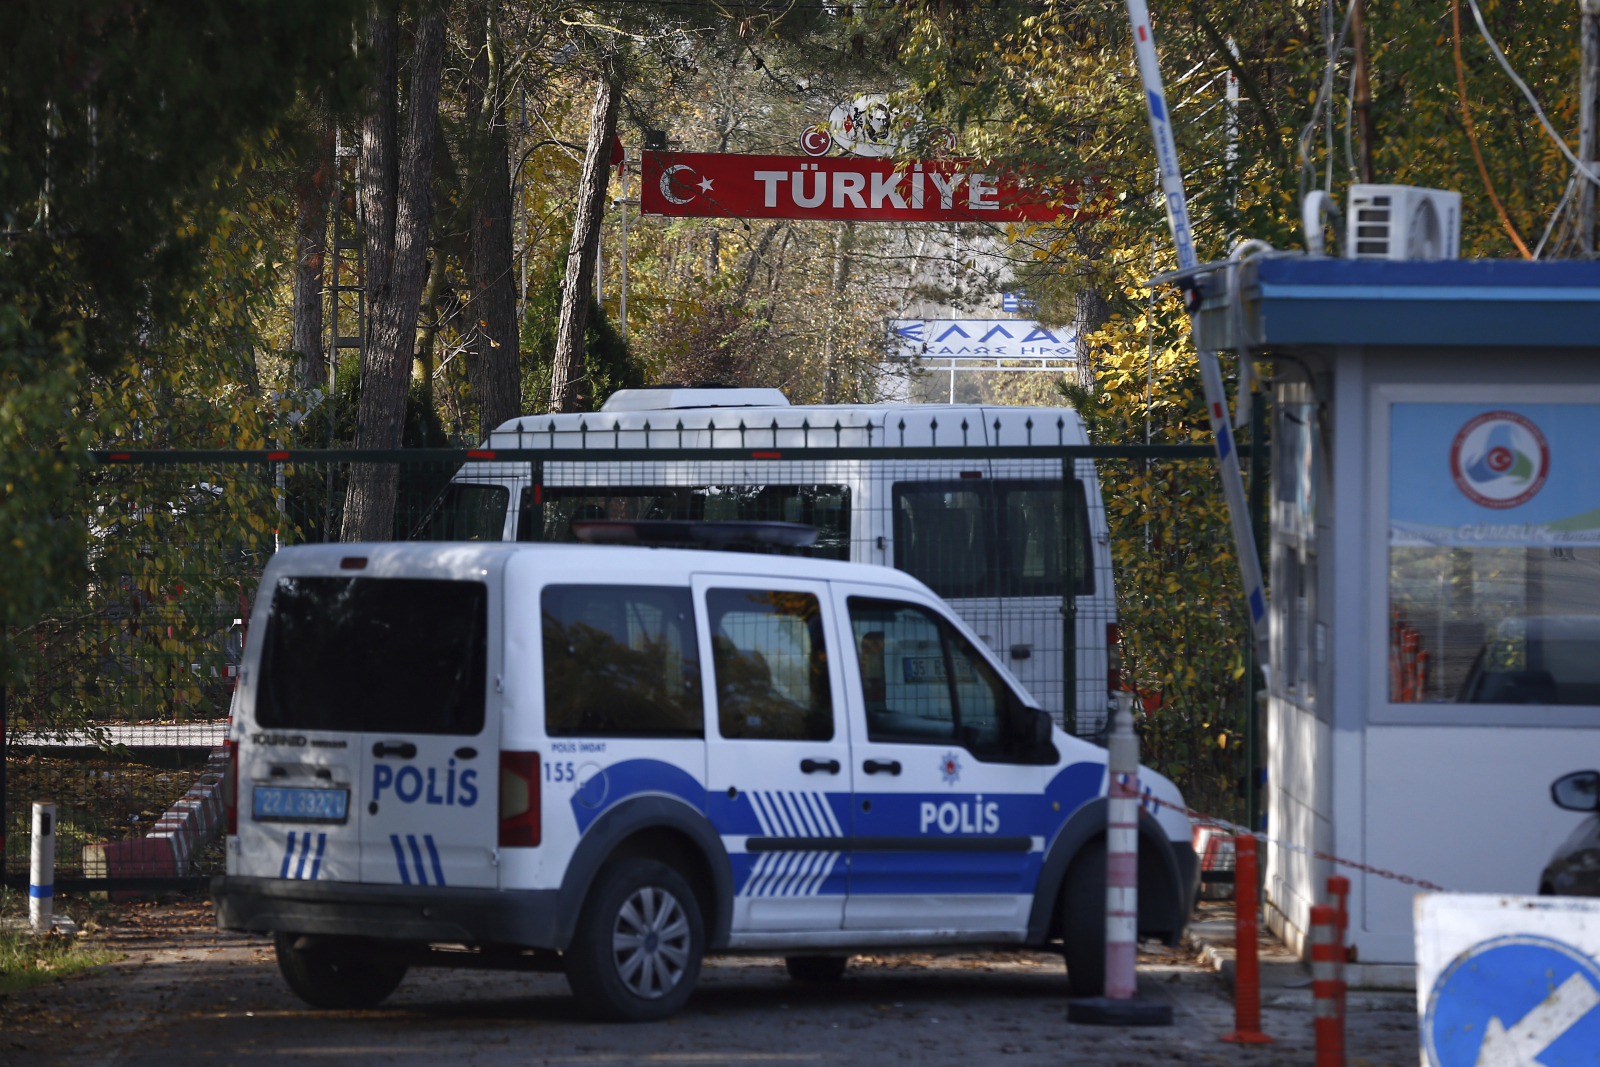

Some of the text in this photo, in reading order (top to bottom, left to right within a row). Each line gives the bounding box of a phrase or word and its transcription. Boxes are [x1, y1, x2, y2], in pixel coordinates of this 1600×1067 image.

[754, 163, 1000, 210] TÜRKİYE
[1021, 346, 1076, 355] ΗΡΘ
[372, 758, 479, 808] POLİS
[543, 761, 575, 783] 155
[262, 791, 282, 813] 22
[920, 793, 1001, 835] POLİS
